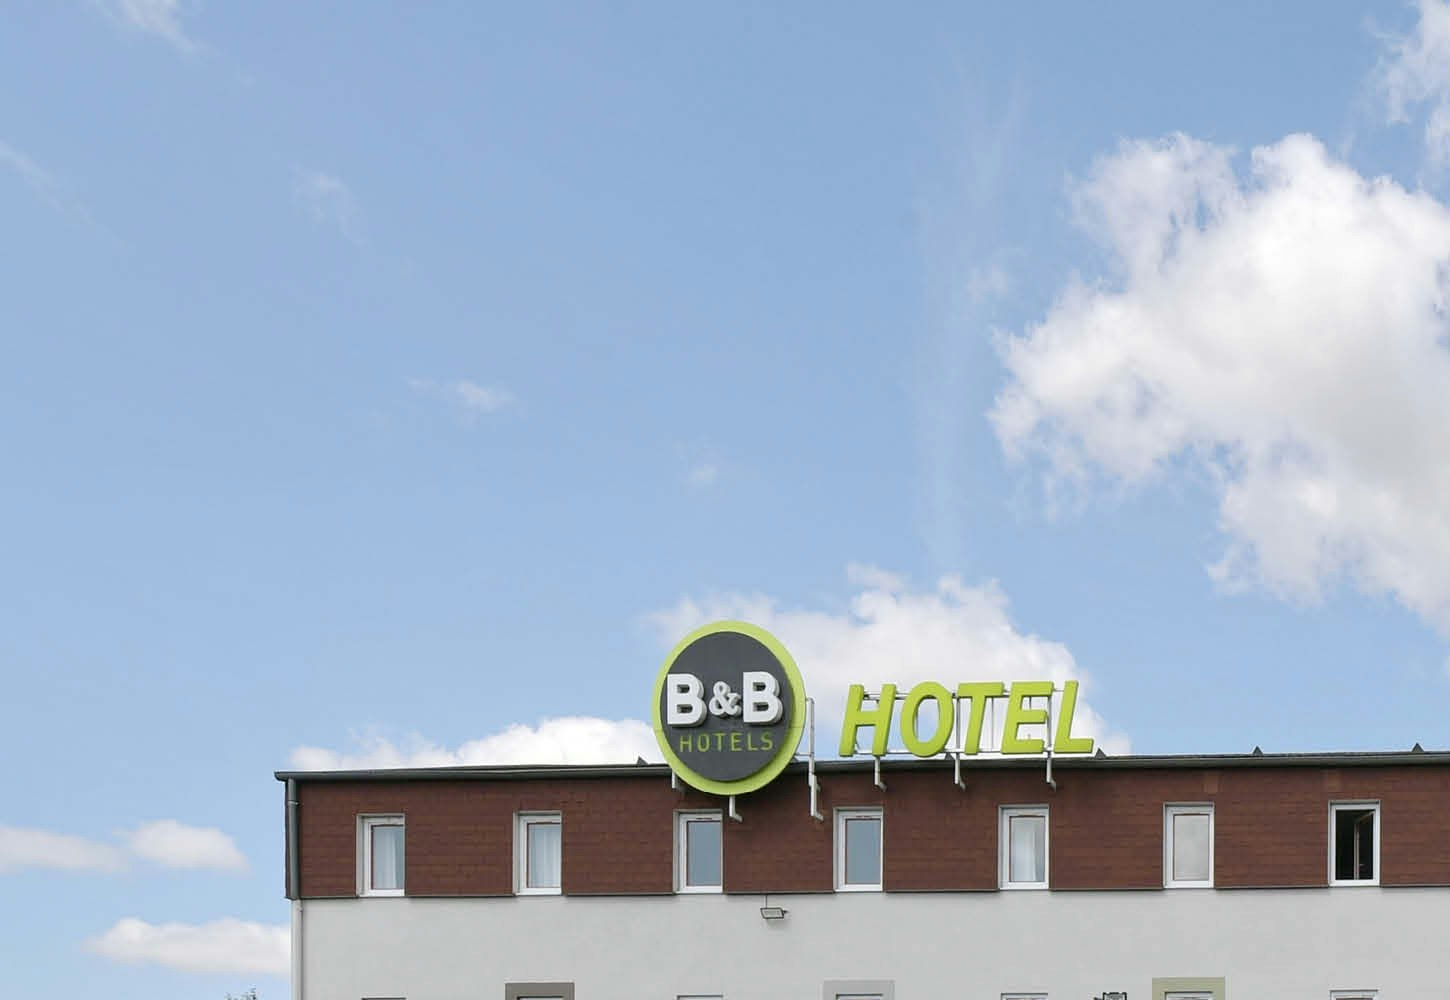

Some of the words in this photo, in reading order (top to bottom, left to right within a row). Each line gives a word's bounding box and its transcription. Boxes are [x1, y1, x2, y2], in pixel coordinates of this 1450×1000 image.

[667, 671, 783, 727] B&B
[839, 680, 1095, 758] HOTEL
[680, 731, 774, 752] HOTELS
